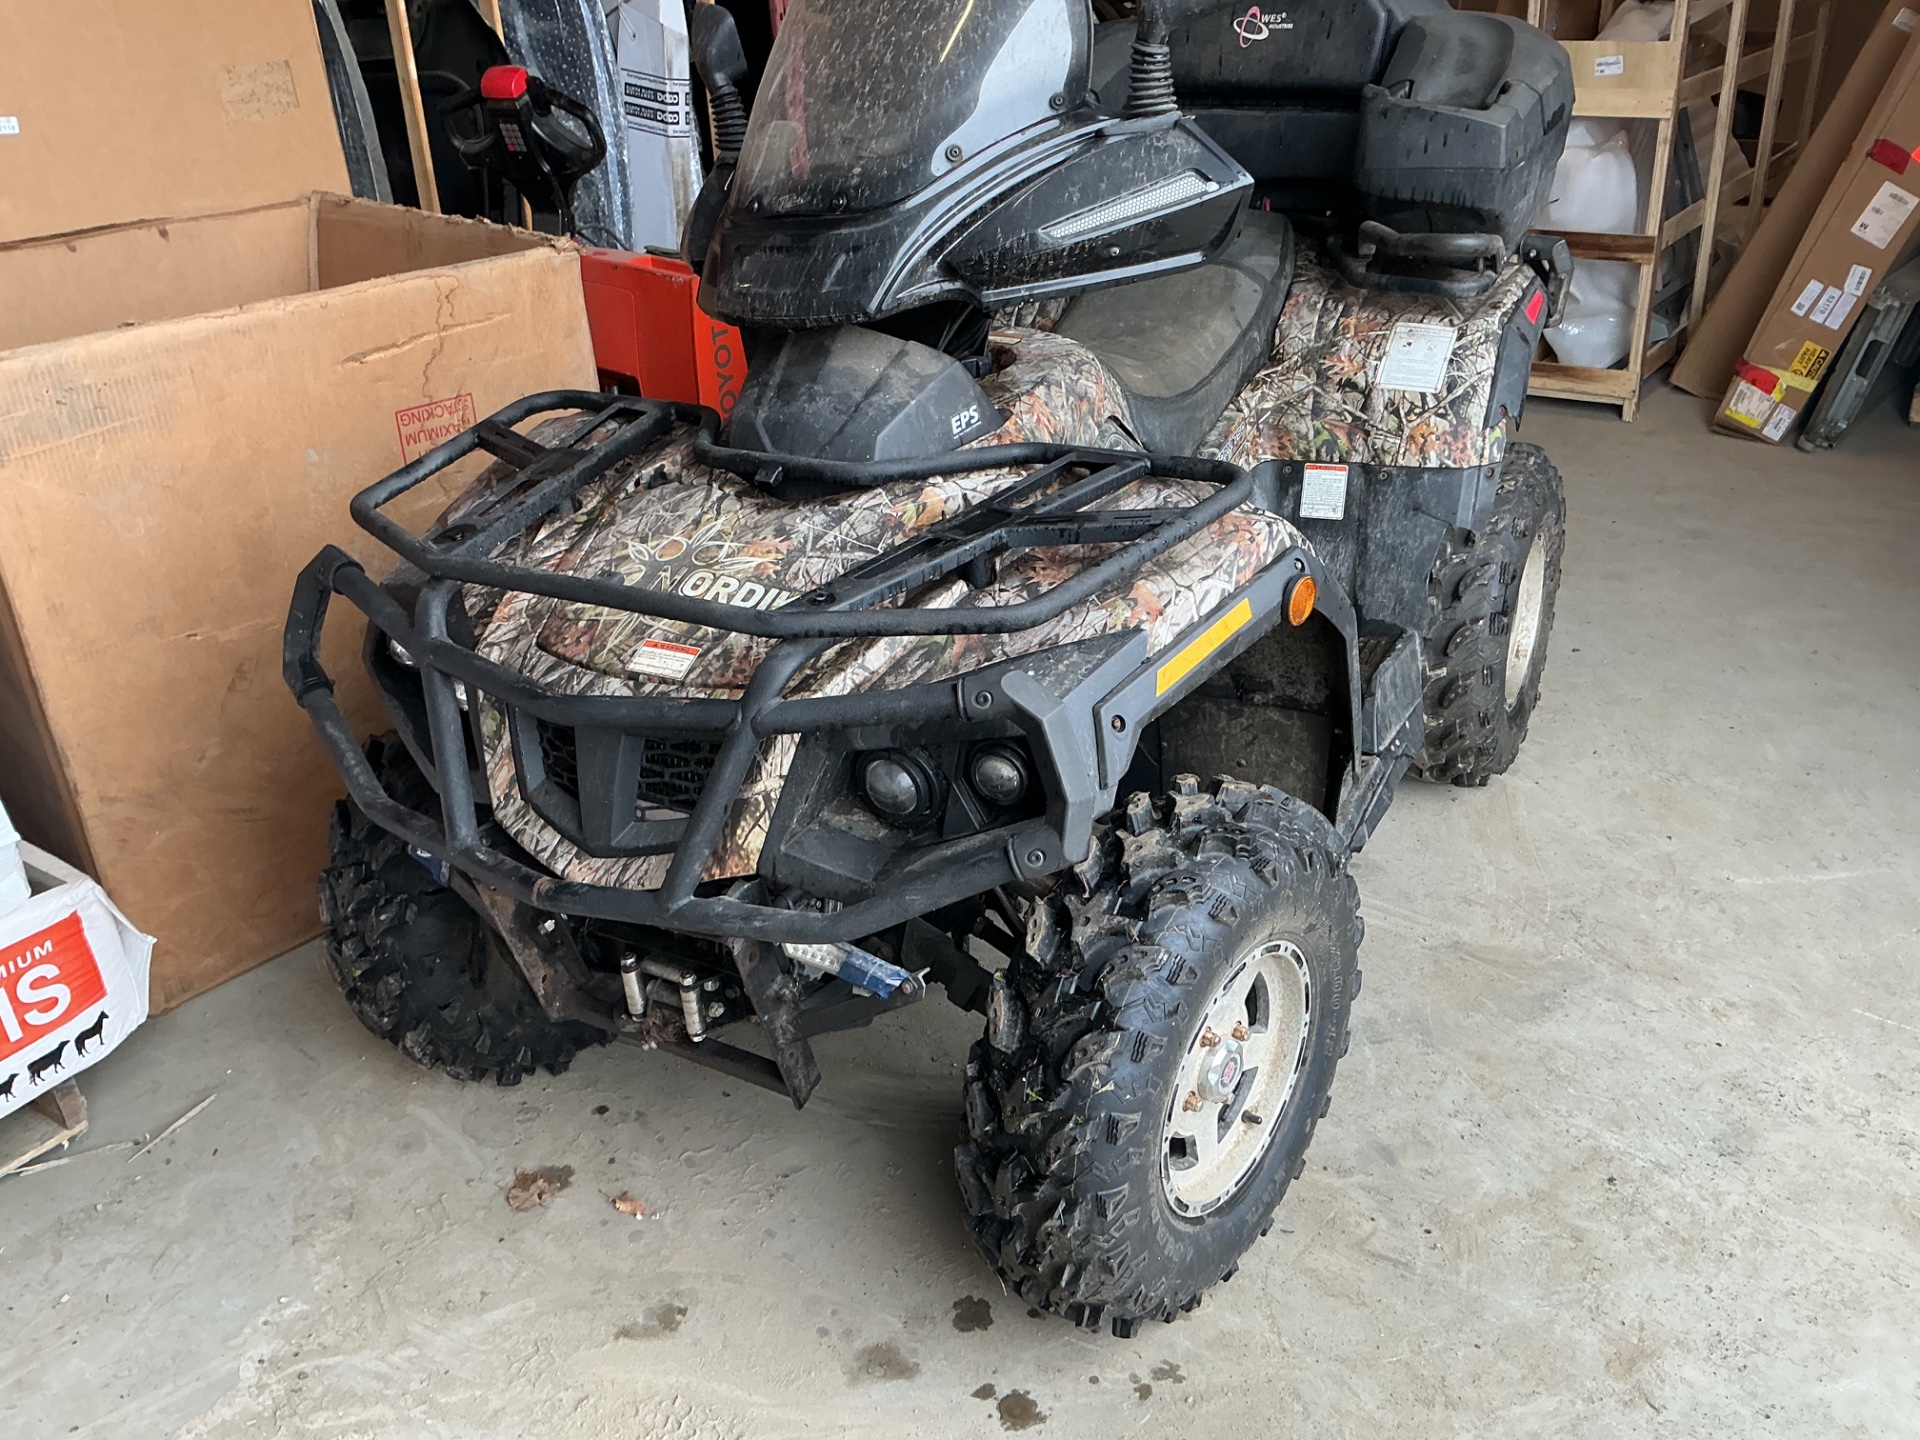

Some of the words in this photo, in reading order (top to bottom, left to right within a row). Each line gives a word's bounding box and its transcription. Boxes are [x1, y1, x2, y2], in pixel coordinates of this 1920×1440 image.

[711, 326, 737, 416] OYOT
[400, 399, 469, 426] STACKING
[951, 405, 979, 435] EPS
